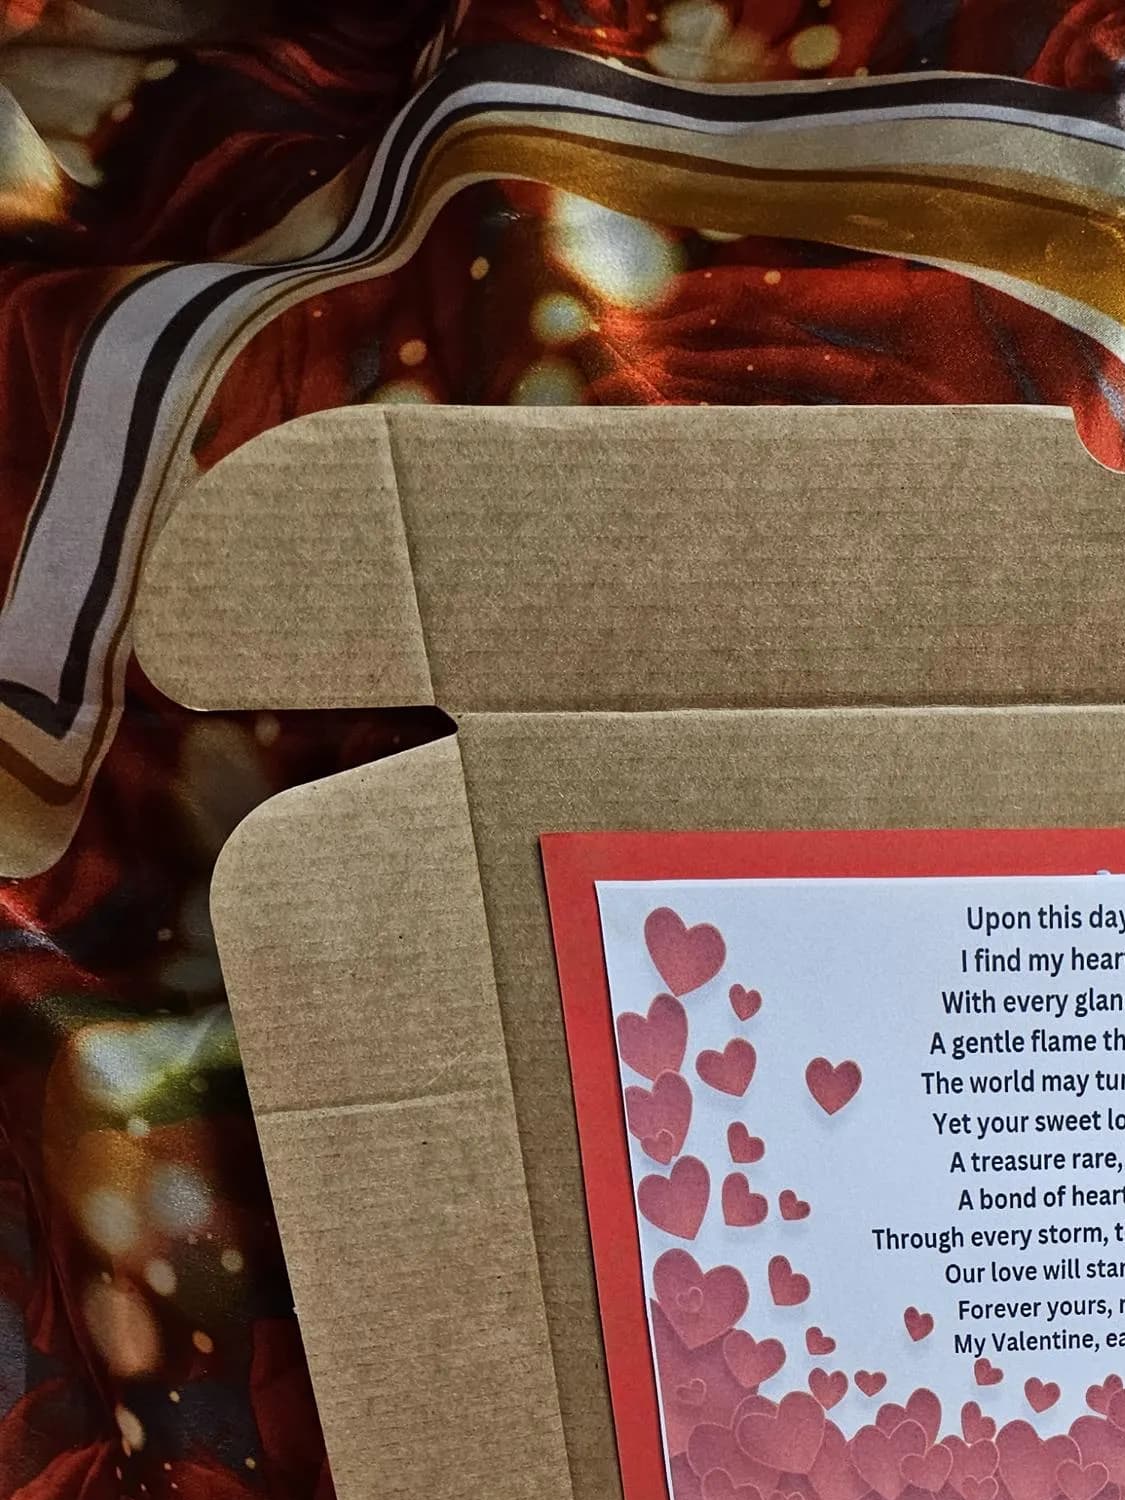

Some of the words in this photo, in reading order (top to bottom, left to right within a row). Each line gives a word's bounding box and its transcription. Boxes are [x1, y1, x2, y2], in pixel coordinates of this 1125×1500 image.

[967, 906, 1031, 937] Upon
[1037, 904, 1083, 930] this
[961, 949, 968, 973] I
[974, 947, 1021, 973] find
[1028, 953, 1065, 978] my
[941, 989, 996, 1014] With
[1003, 993, 1069, 1019] every
[929, 1031, 947, 1055] A
[951, 1029, 1025, 1061] gentle
[1030, 1028, 1097, 1053] flame
[920, 1070, 964, 1095] The
[969, 1068, 1035, 1094] world
[1042, 1073, 1090, 1098] may
[932, 1112, 972, 1135] Yet
[976, 1115, 1030, 1140] your
[1034, 1110, 1102, 1133] sweet
[949, 1151, 966, 1174] A
[970, 1152, 1066, 1173] treasure
[1072, 1151, 1123, 1174] rare,
[958, 1189, 974, 1211] A
[979, 1186, 1037, 1210] bond
[1043, 1184, 1067, 1208] of
[871, 1225, 964, 1254] Through
[971, 1228, 1033, 1251] every
[1038, 1224, 1109, 1247] storm,
[945, 1263, 986, 1284] Our
[991, 1261, 1038, 1283] love
[1042, 1257, 1081, 1281] will
[958, 1300, 1042, 1321] Forever
[1046, 1299, 1113, 1322] yours,
[954, 1333, 986, 1359] My
[991, 1328, 1100, 1353] Valentine,
